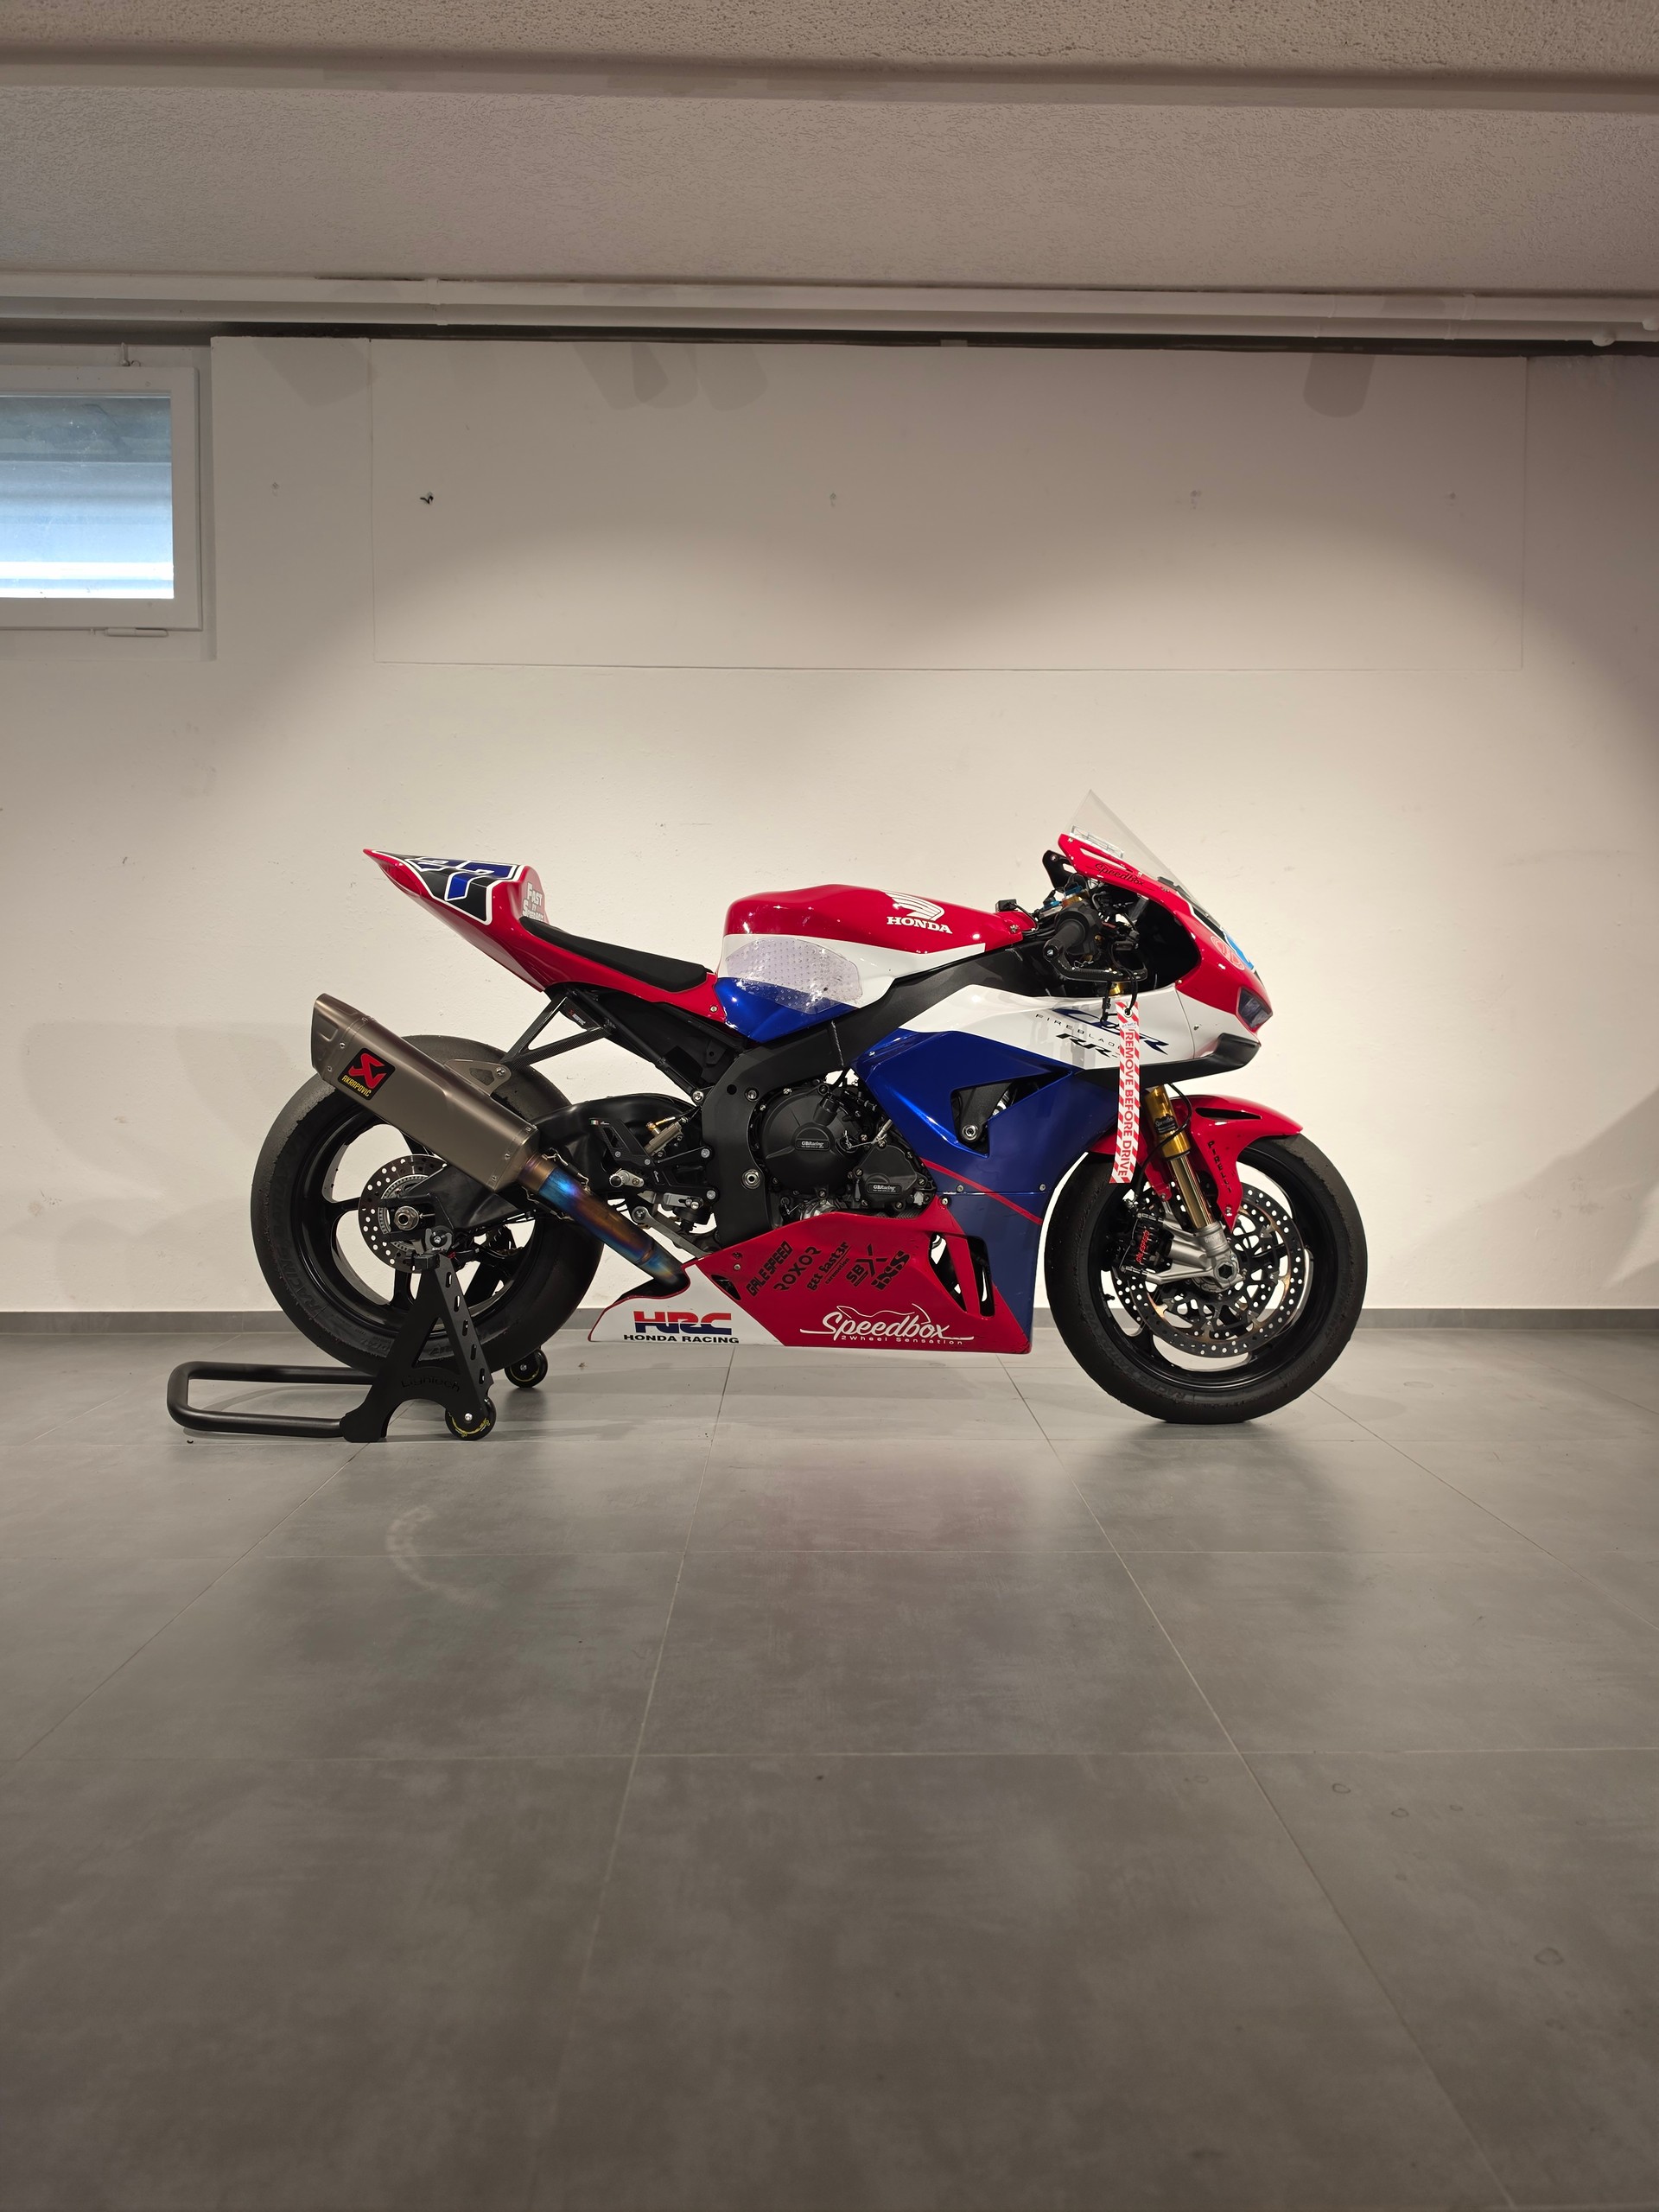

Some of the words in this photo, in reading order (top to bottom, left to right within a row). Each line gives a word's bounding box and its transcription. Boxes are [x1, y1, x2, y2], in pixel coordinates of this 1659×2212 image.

[1095, 862, 1144, 887] Speedbox
[527, 881, 543, 906] FAST
[886, 916, 953, 934] HONDA
[1125, 1032, 1134, 1085] REMOVE
[1122, 1090, 1134, 1137] BEFORE
[1117, 1141, 1132, 1176] DRIVE
[1207, 1140, 1232, 1193] PIRELLI
[773, 1246, 822, 1291] ROXOR
[806, 1273, 823, 1291] get
[633, 1311, 732, 1335] HRC
[817, 1308, 952, 1341] Speedbox
[896, 1337, 963, 1345] Sensation
[401, 1375, 460, 1392] LighTech
